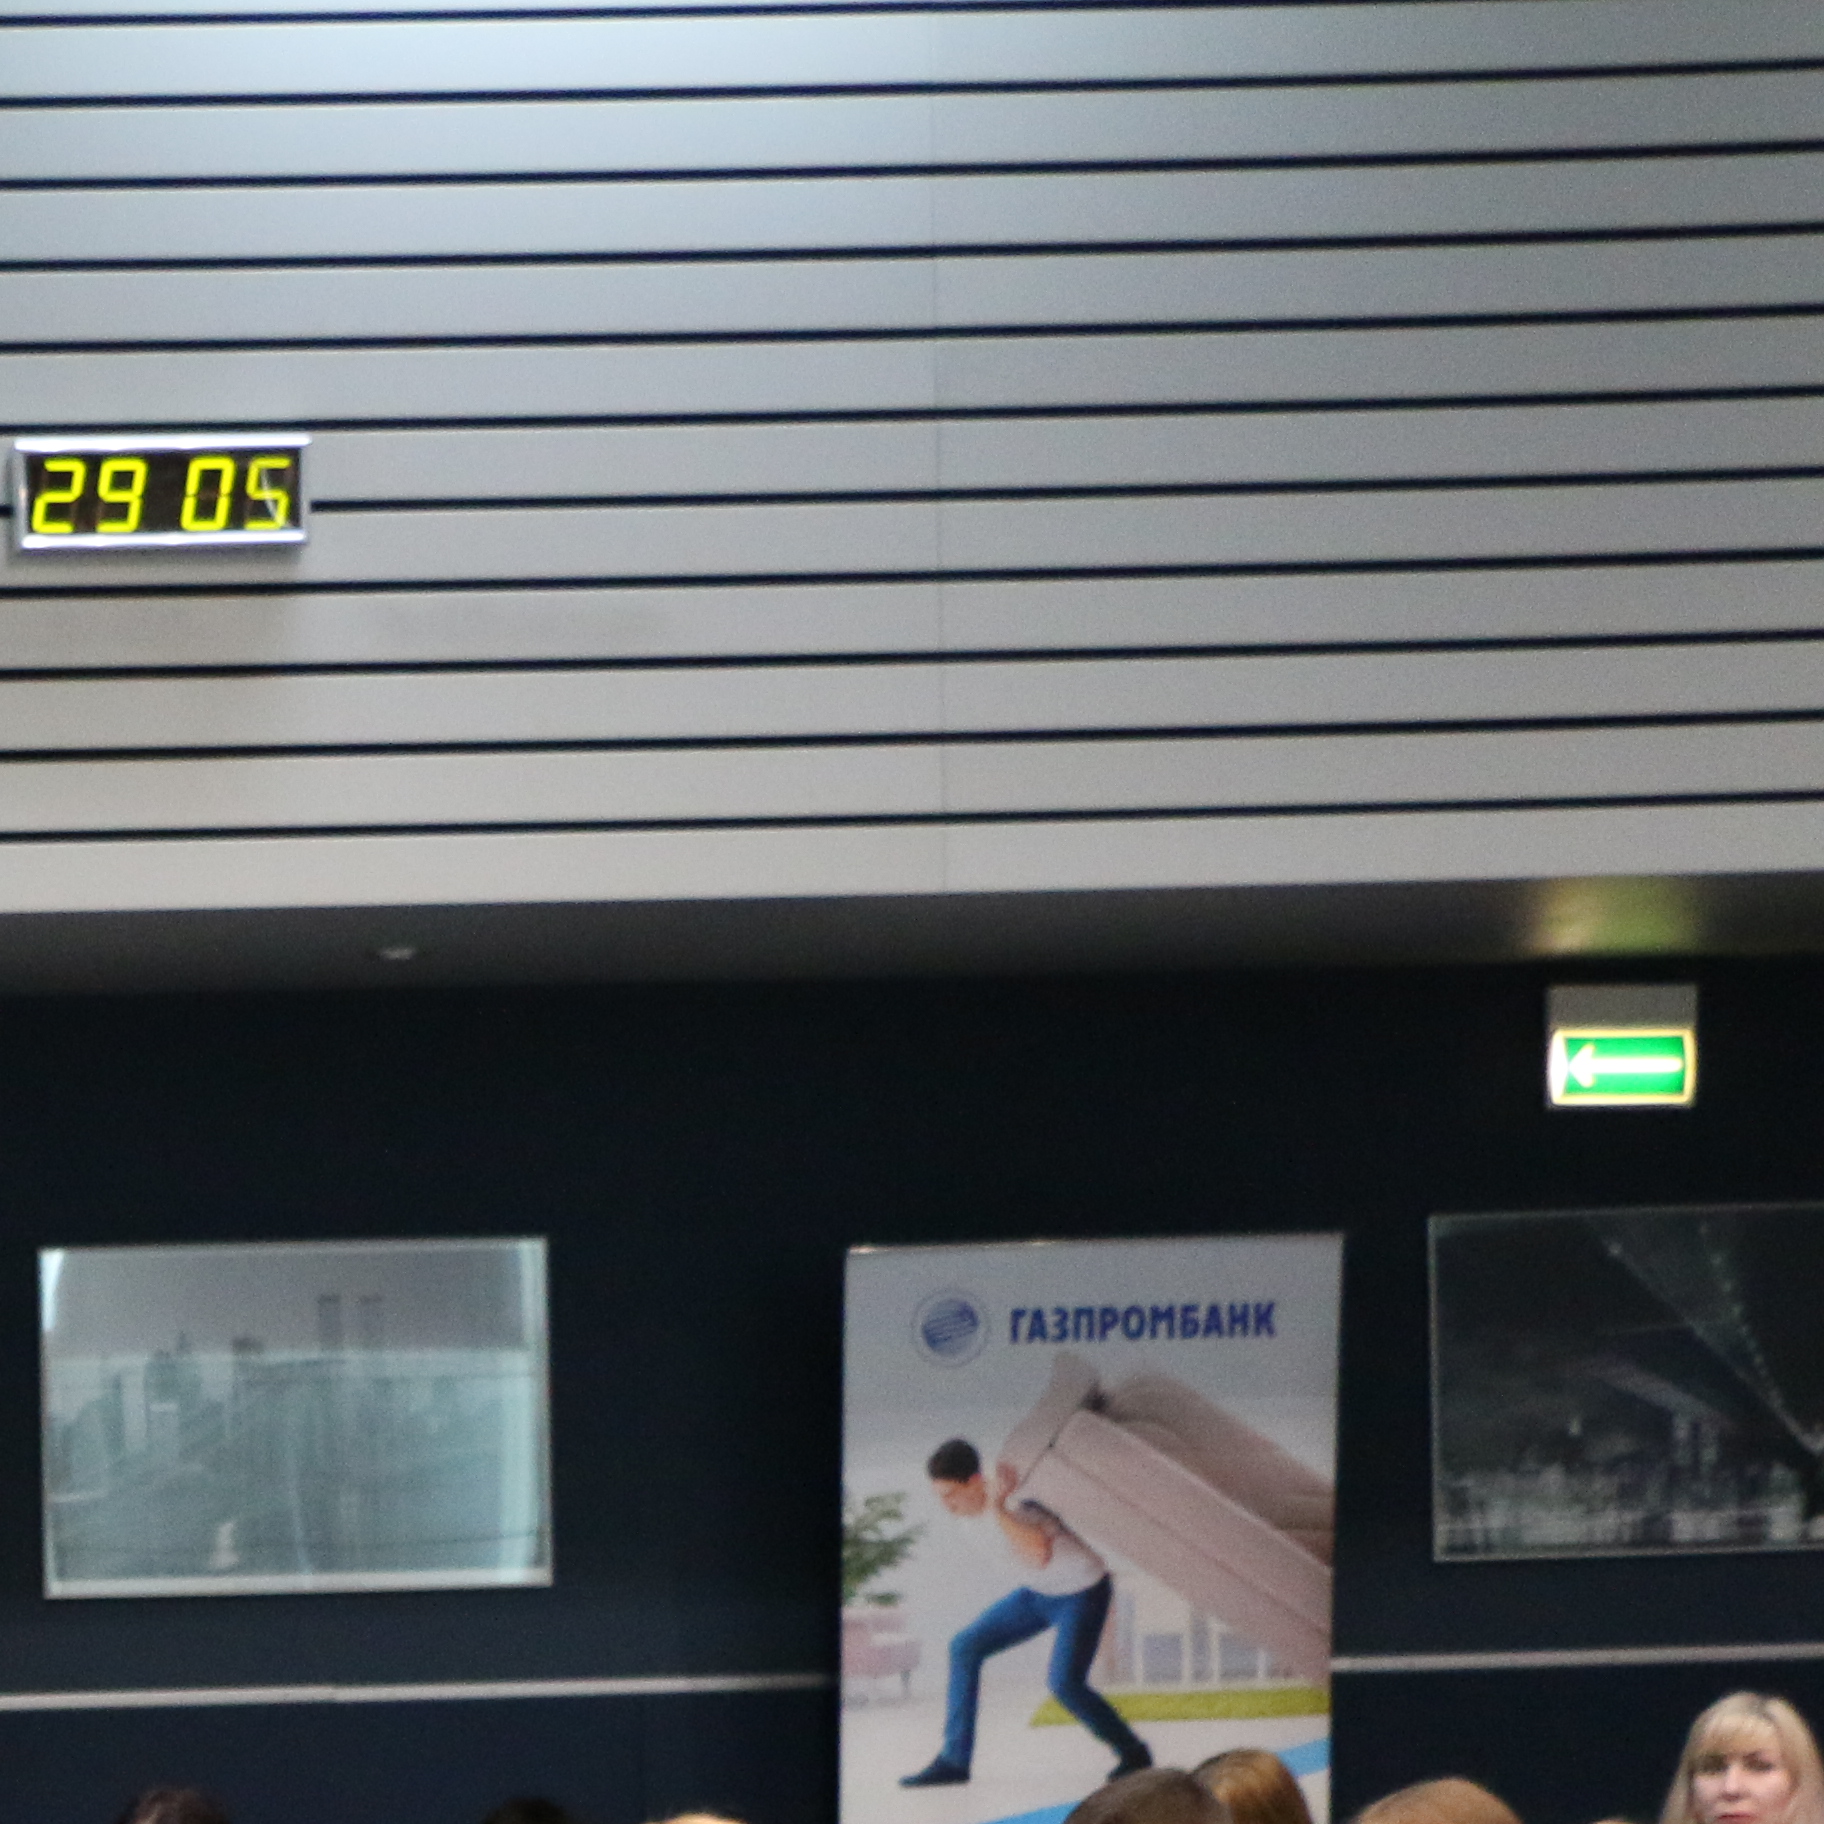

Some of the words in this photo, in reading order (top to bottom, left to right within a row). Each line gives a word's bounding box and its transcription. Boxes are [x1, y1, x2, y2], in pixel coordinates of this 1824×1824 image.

[32, 456, 148, 534] 29
[181, 455, 293, 532] 05
[1009, 1301, 1278, 1343] ГАЗПРОМБАНК
